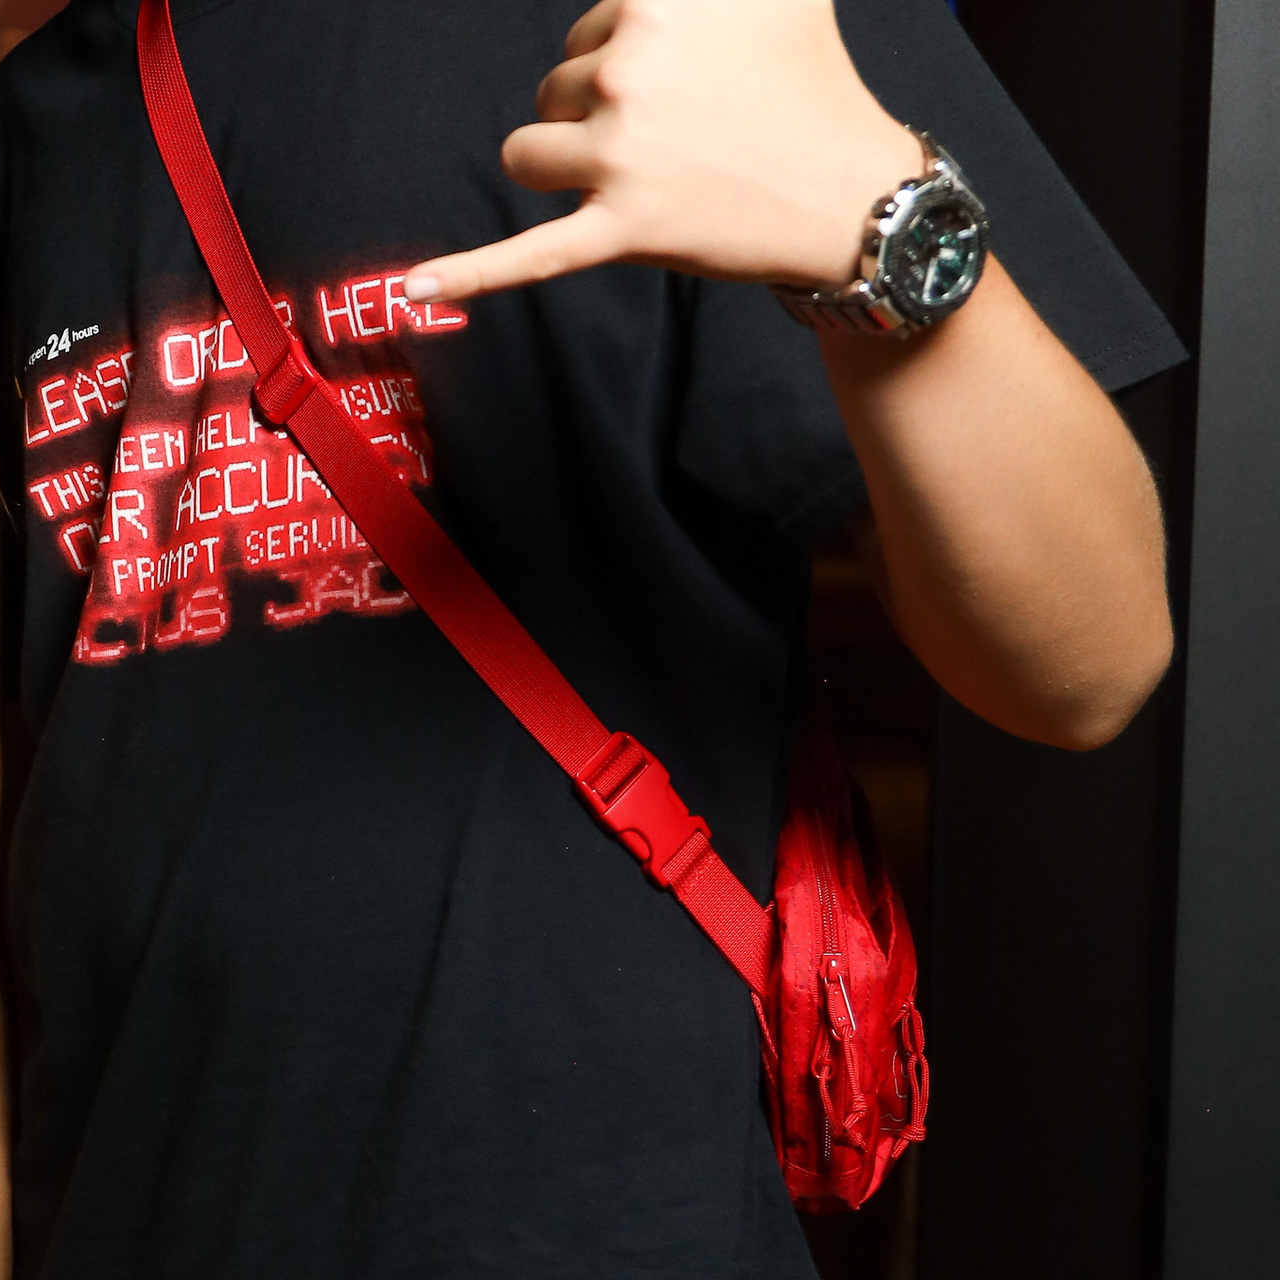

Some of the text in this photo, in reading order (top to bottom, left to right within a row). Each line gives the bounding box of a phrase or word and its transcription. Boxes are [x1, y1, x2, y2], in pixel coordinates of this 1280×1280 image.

[46, 327, 72, 361] 24
[71, 324, 100, 343] hours
[29, 464, 106, 517] THIS
[114, 428, 186, 475] EEN
[111, 535, 220, 595] PROMPT
[267, 560, 410, 622] JAC
